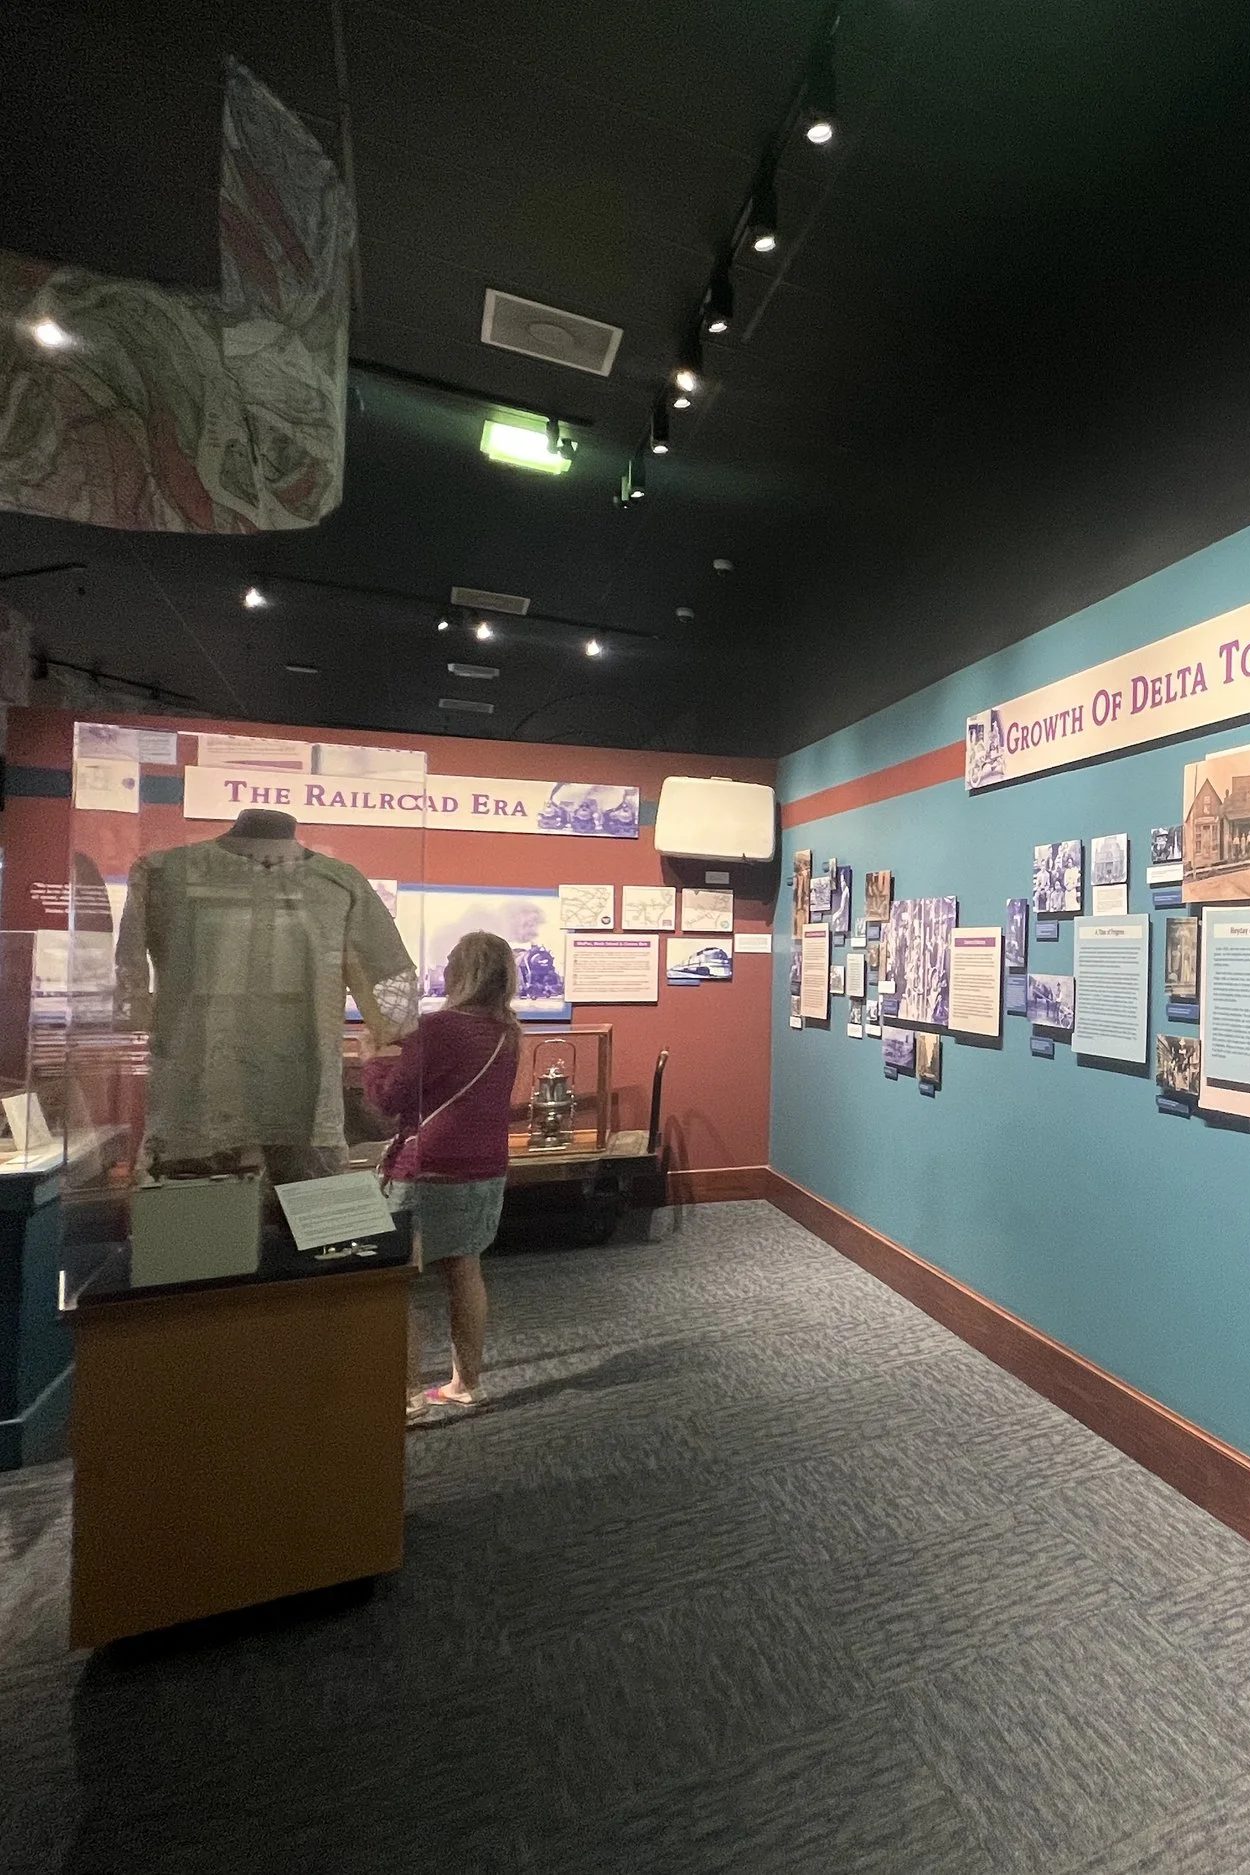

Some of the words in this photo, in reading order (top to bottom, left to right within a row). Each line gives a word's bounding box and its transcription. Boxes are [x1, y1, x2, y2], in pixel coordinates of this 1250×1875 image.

[1006, 705, 1084, 754] GROWTH
[1092, 689, 1122, 726] OF
[1130, 662, 1208, 715] DELTA
[224, 780, 291, 805] THE
[471, 793, 528, 817] ERA
